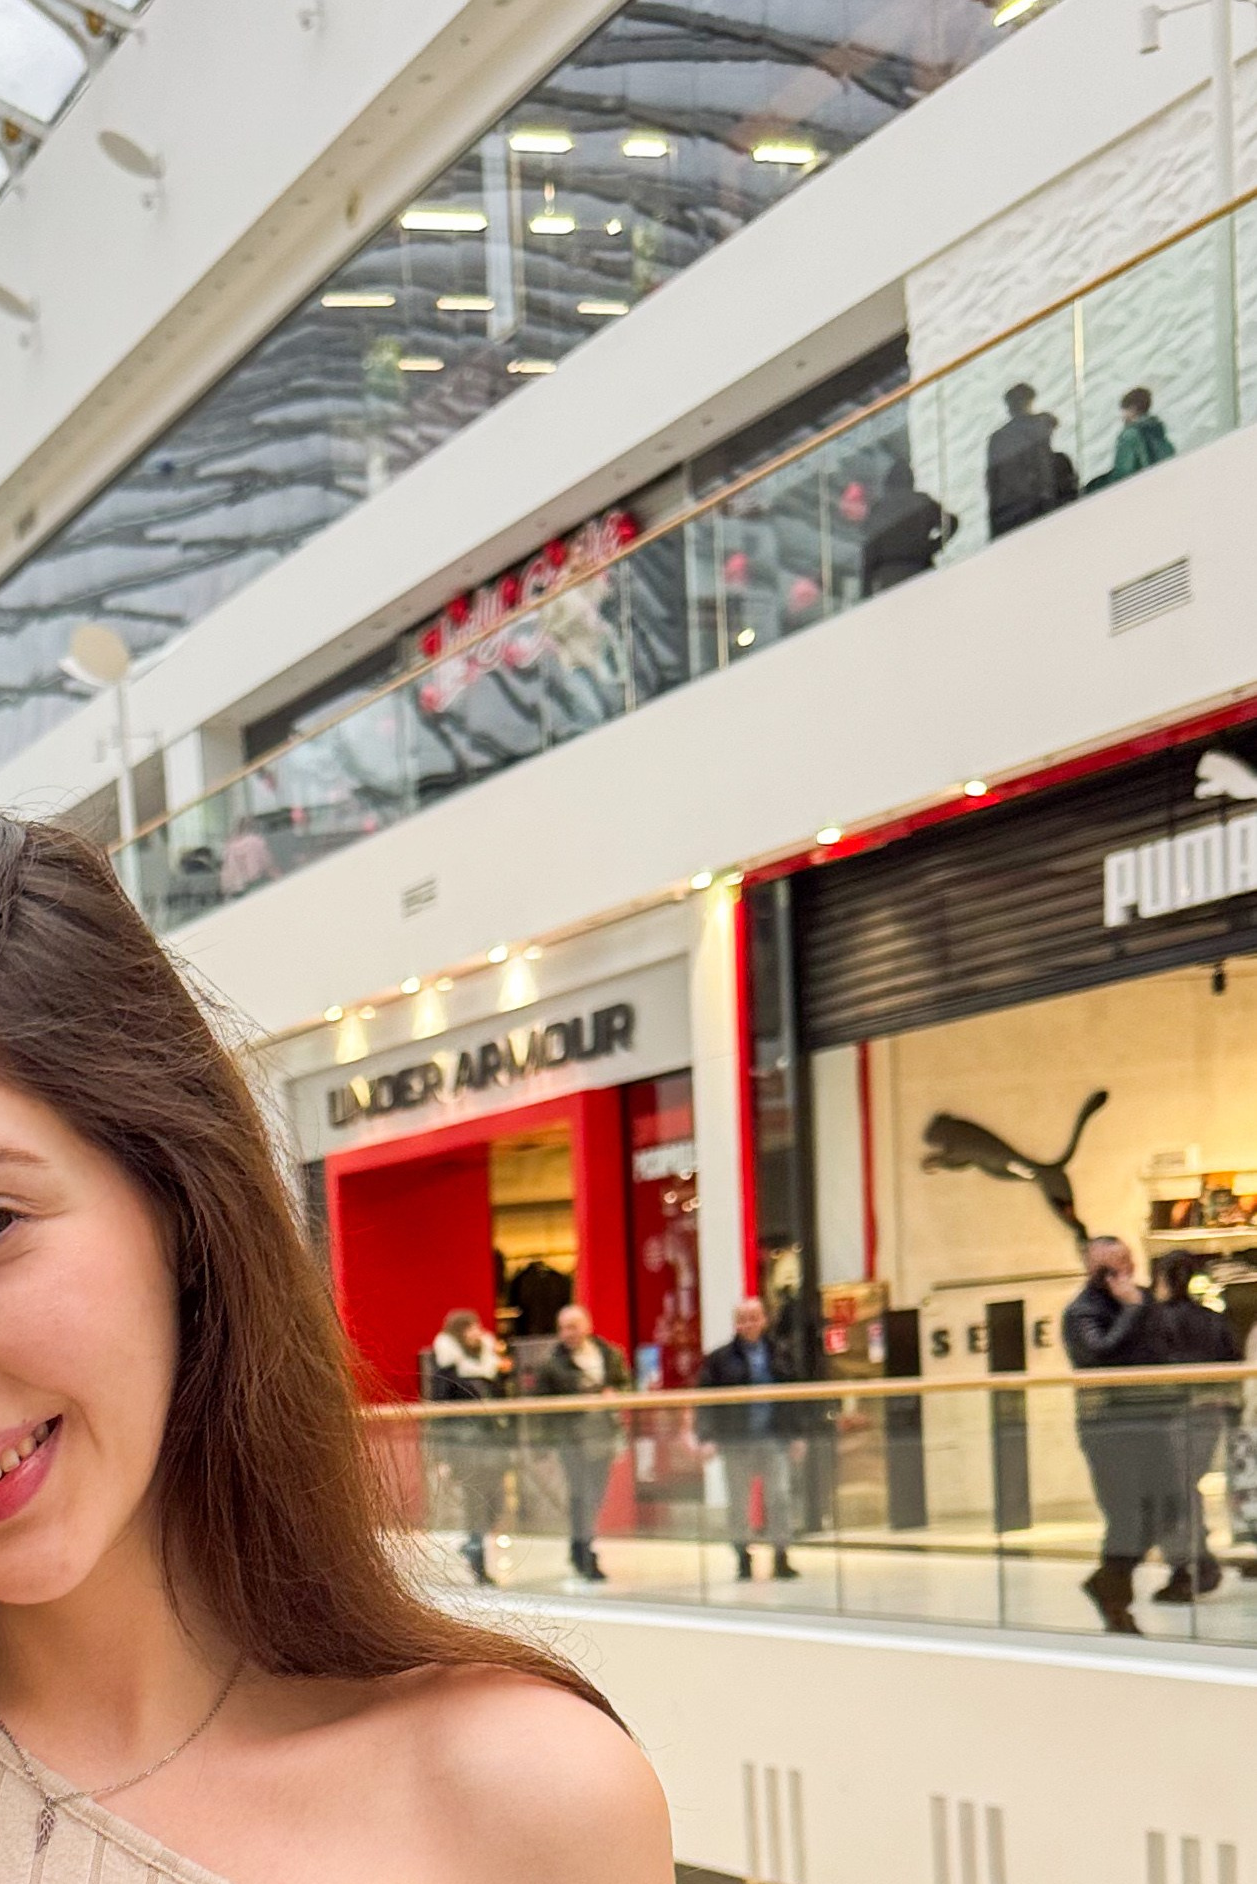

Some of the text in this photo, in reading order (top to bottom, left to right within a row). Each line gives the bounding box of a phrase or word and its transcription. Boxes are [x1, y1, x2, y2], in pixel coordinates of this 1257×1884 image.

[1103, 811, 1257, 927] PUMA
[327, 1001, 637, 1130] UNDER ARMOUR
